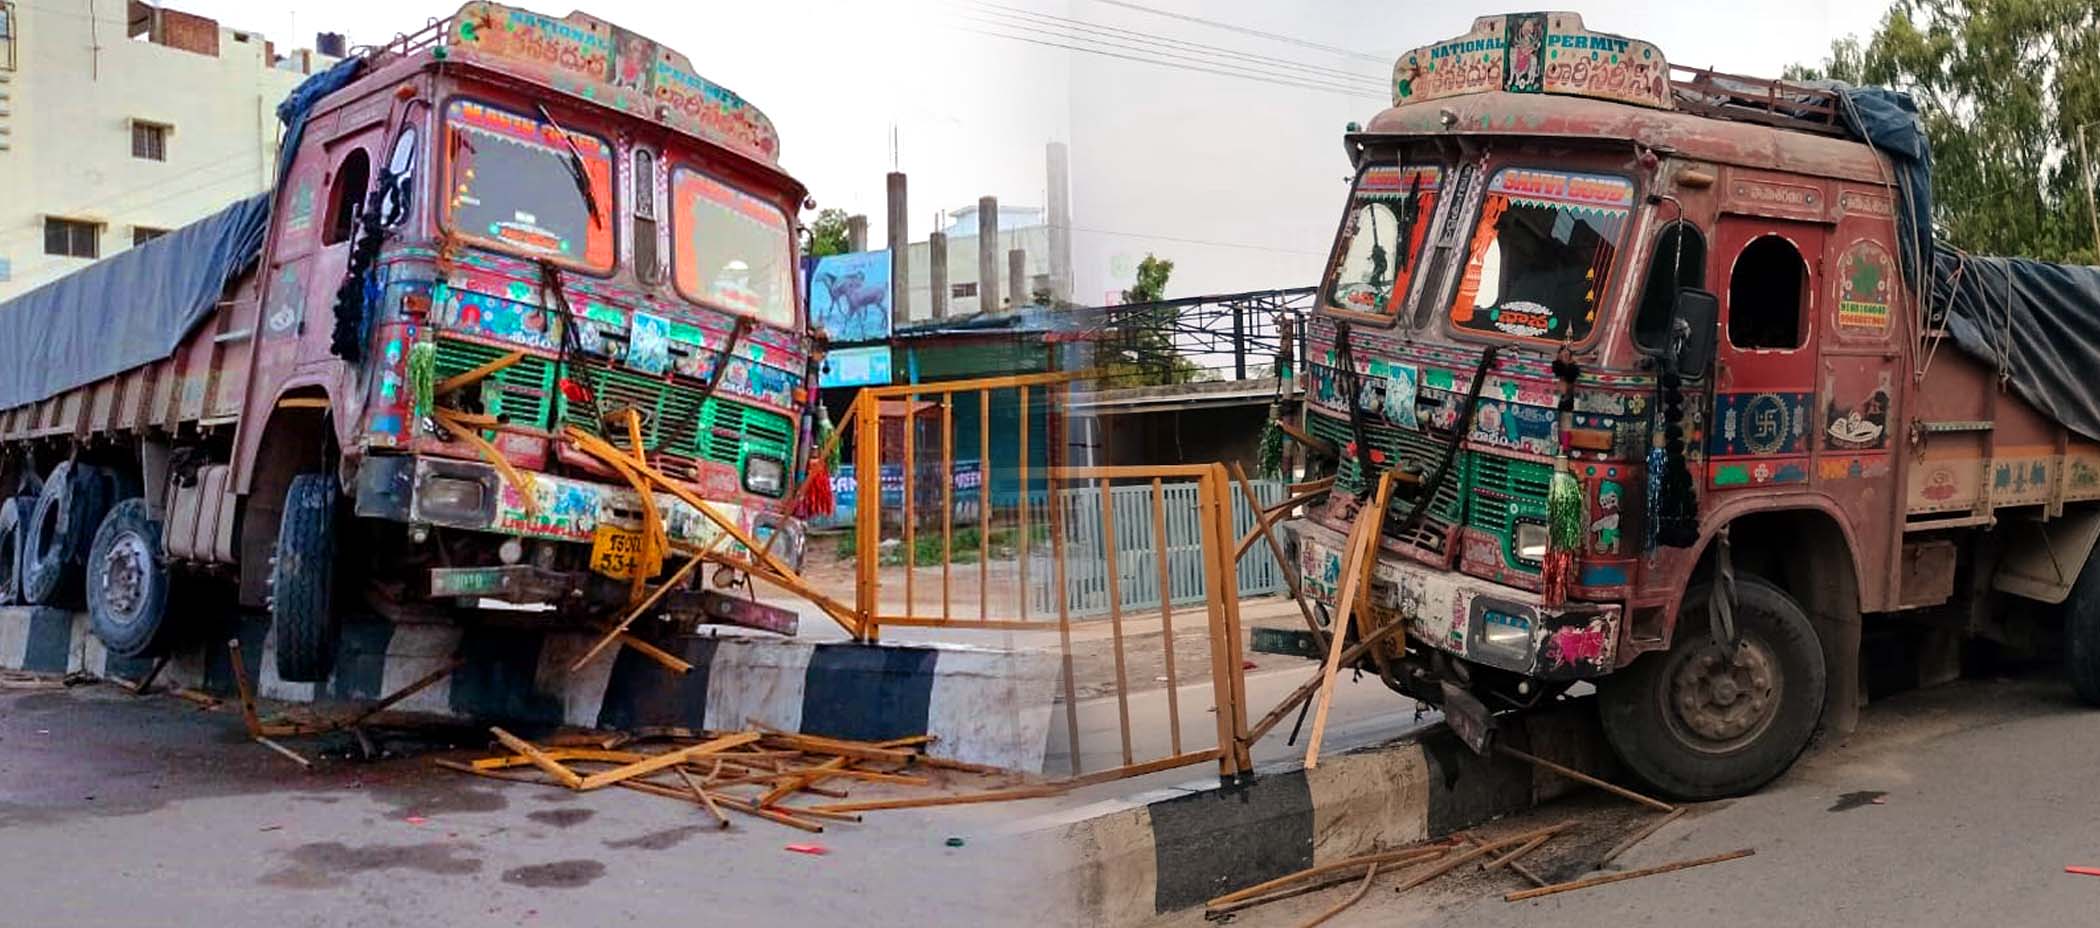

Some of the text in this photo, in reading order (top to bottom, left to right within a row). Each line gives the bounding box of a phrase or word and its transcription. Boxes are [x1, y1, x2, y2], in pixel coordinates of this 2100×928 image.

[511, 11, 745, 110] NATIONAL PERMIT
[1431, 34, 1629, 59] NATIONAL PERMIT
